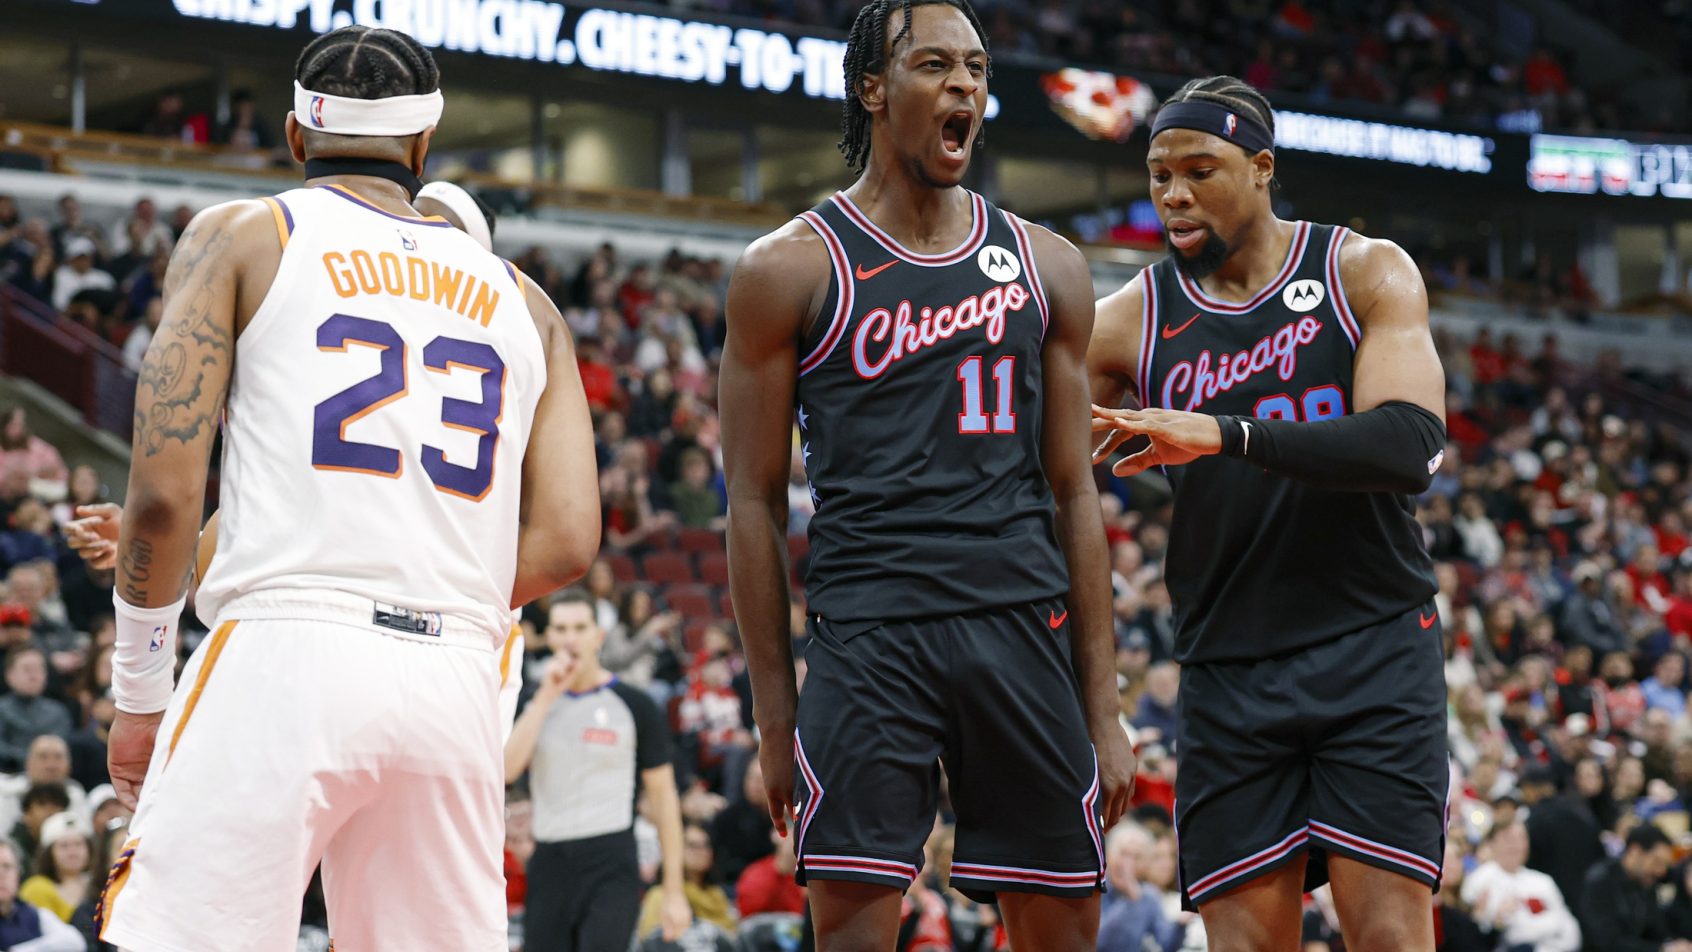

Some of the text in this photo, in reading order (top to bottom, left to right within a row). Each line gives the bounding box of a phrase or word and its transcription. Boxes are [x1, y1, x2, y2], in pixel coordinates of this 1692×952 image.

[321, 249, 500, 329] GOODWIN
[851, 282, 1030, 380] Chicago
[311, 313, 508, 503] 23
[956, 355, 1017, 434] 11
[1161, 315, 1324, 412] Chicago
